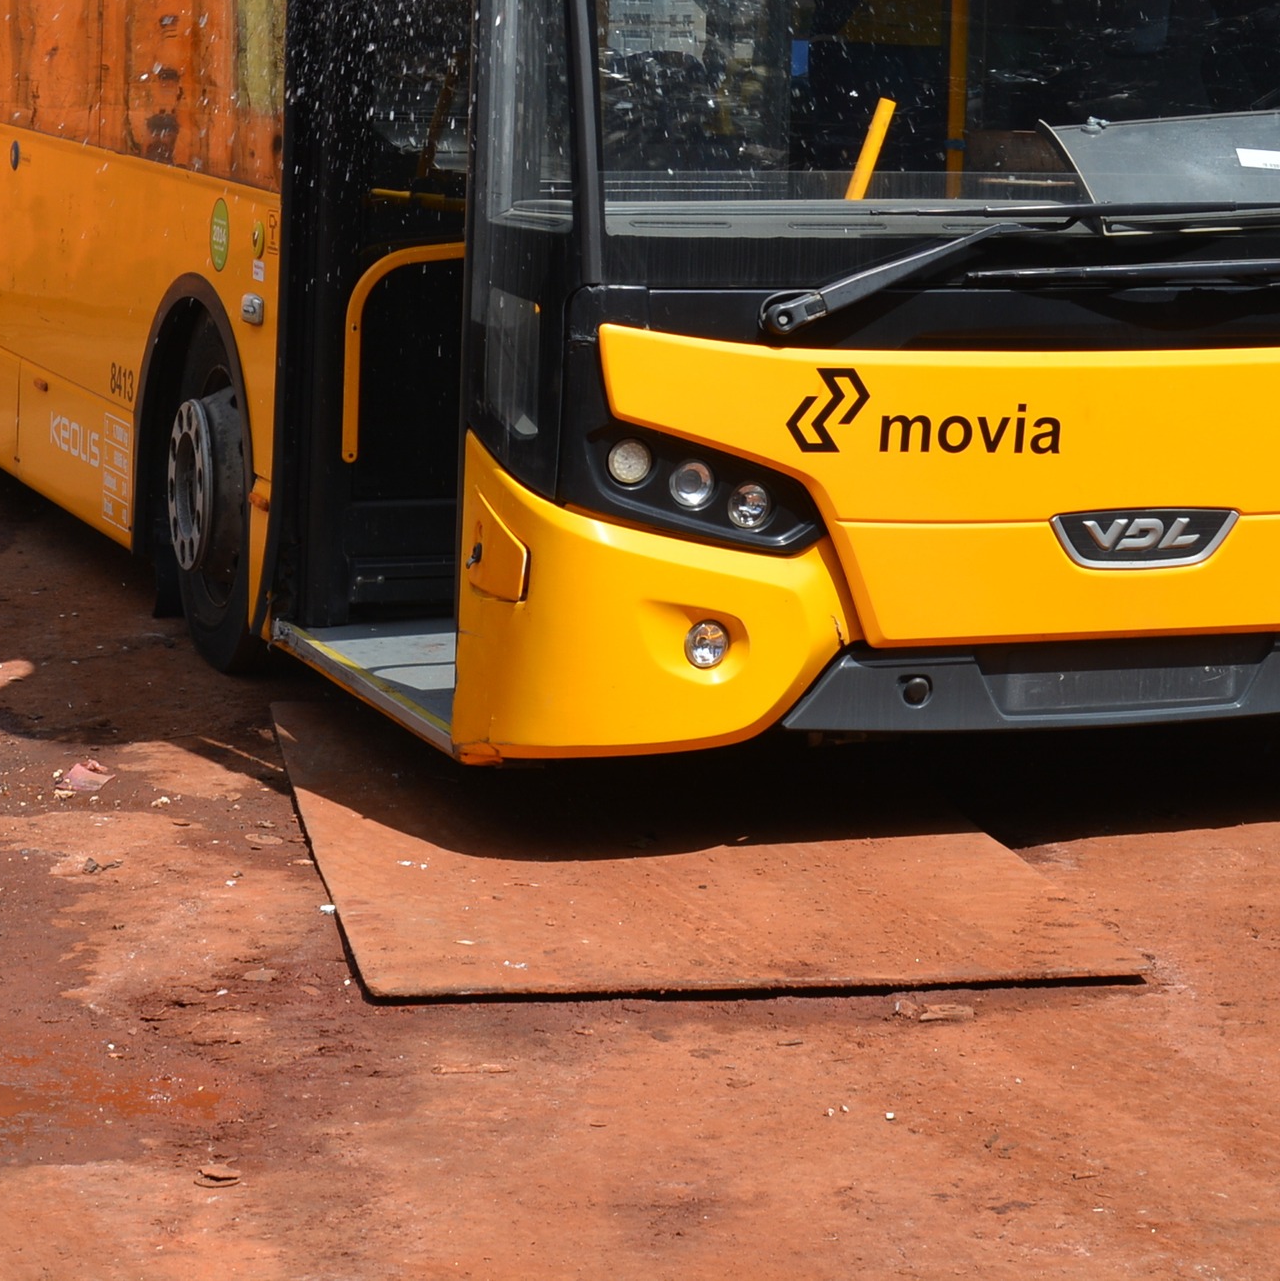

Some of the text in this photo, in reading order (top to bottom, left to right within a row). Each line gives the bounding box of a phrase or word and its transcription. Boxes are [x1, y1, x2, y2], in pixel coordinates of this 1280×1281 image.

[110, 362, 134, 403] 8413
[878, 403, 1062, 455] movia
[1082, 517, 1201, 551] VDL
